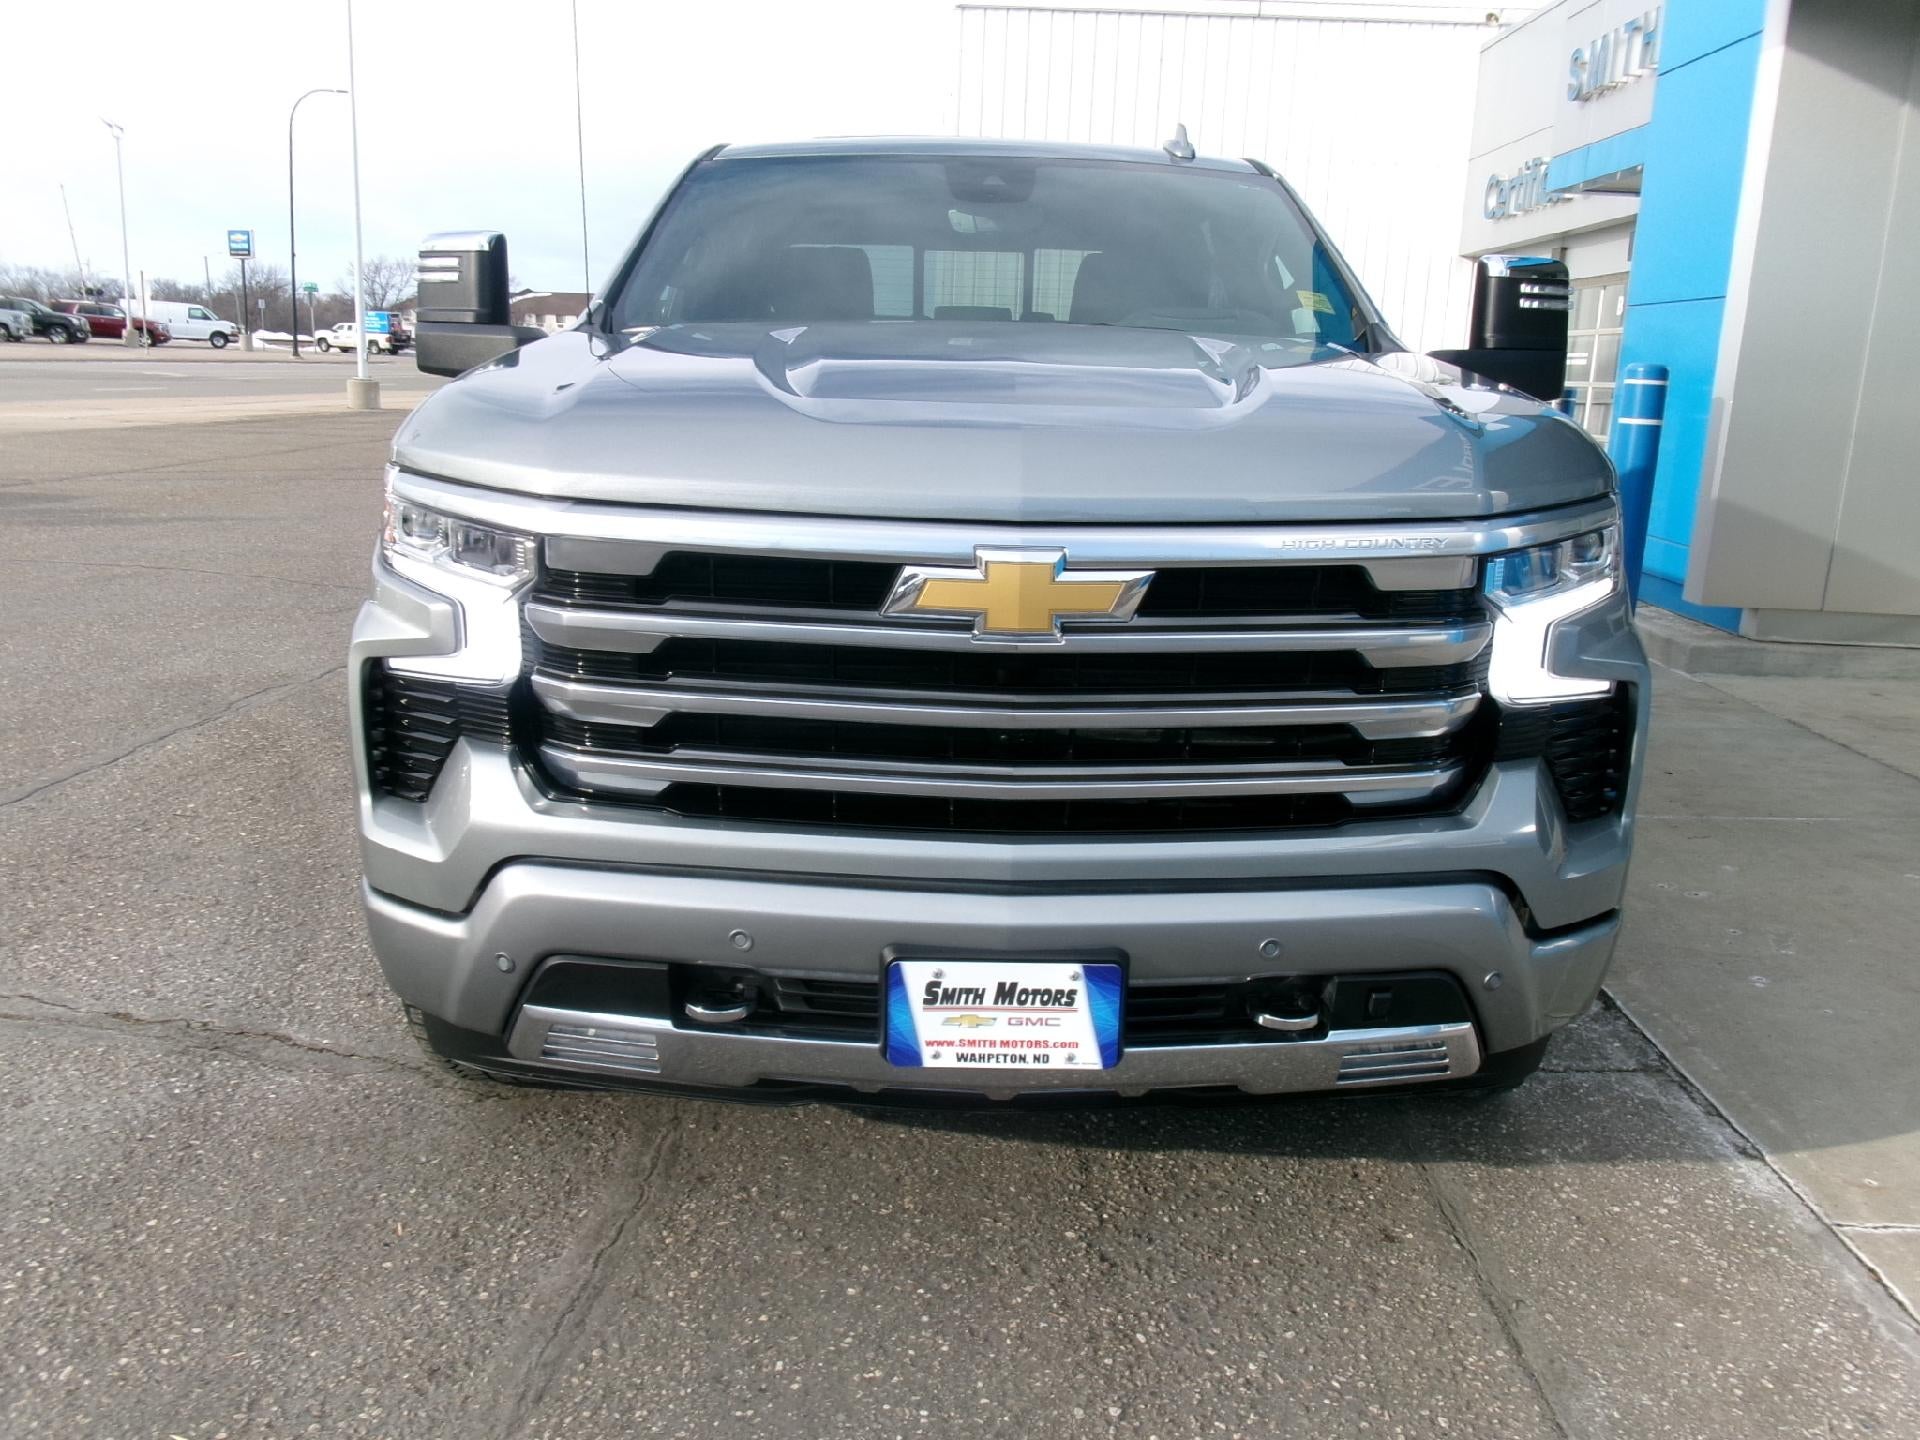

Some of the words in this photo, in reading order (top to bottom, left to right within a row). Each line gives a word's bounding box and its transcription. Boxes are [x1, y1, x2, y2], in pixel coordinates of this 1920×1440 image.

[1567, 6, 1661, 102] SMITH
[1281, 539, 1336, 550] HIGH
[1344, 536, 1449, 549] COUNTRY
[922, 980, 986, 1006] SMITH
[993, 981, 1078, 1007] MOTORS
[1007, 1017, 1061, 1027] GMC
[1032, 1054, 1050, 1064] ND
